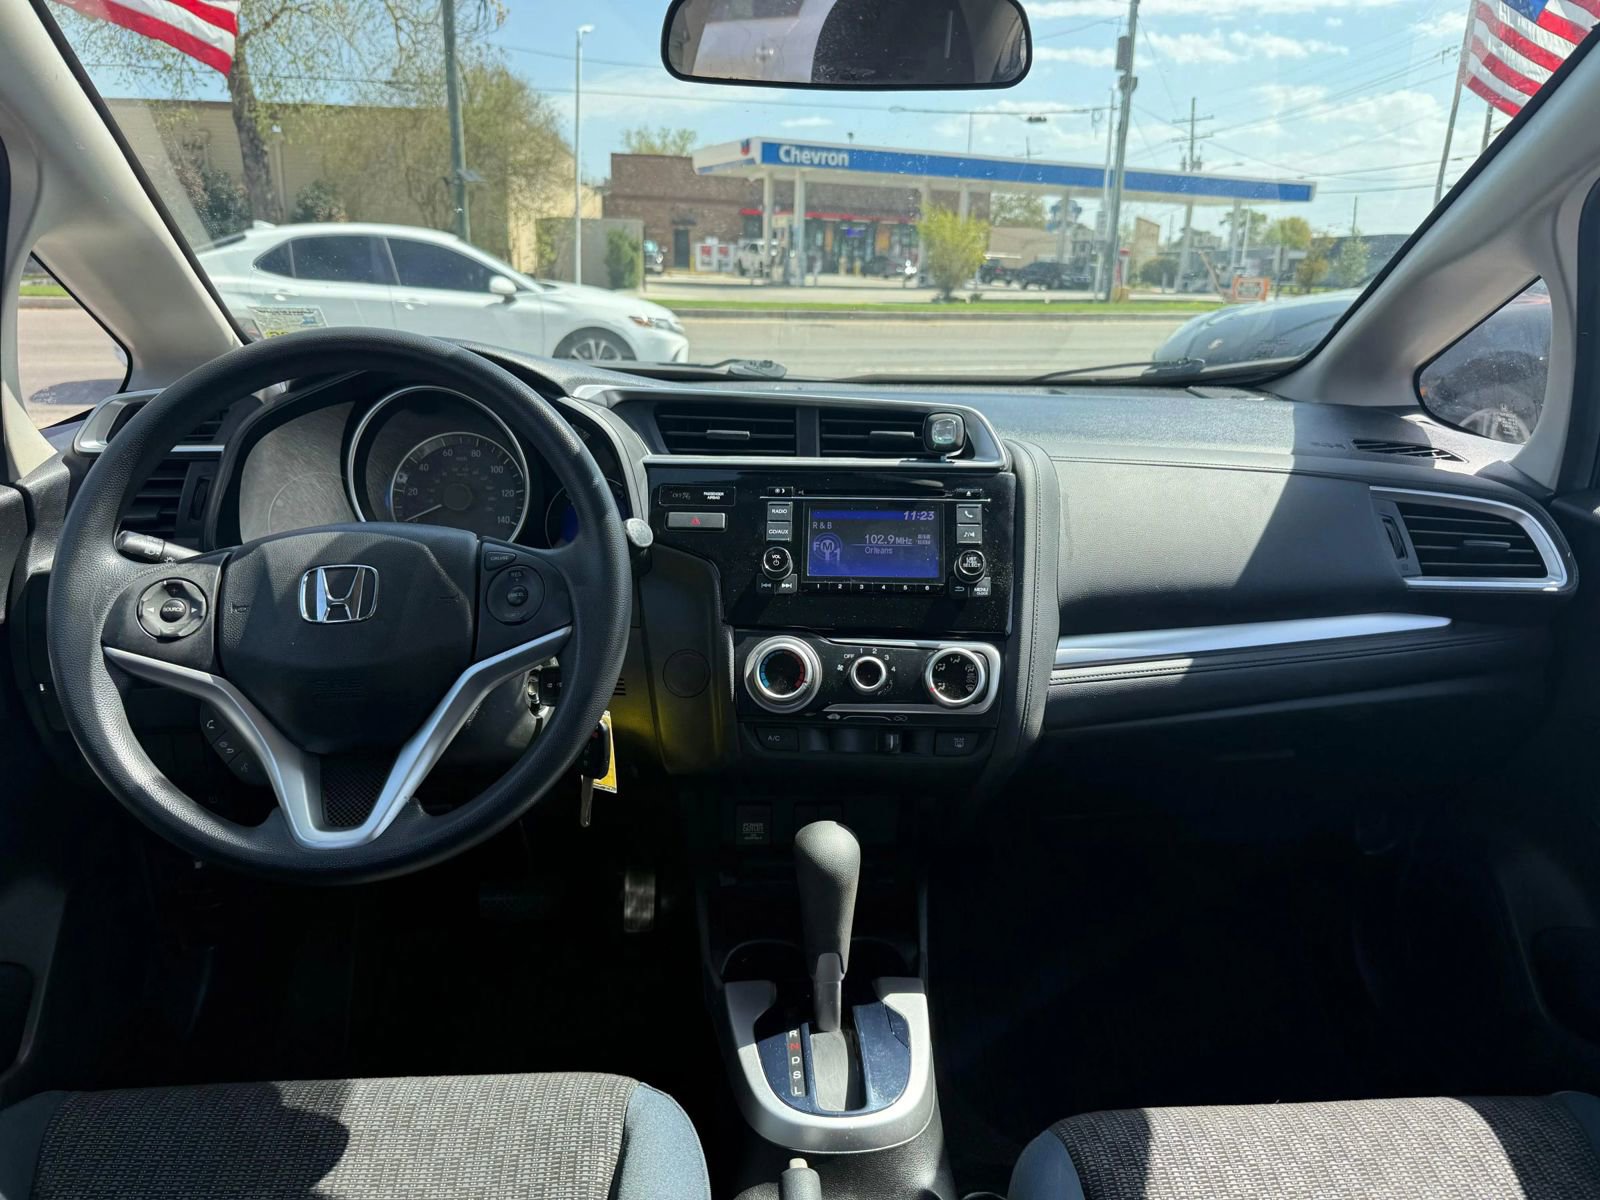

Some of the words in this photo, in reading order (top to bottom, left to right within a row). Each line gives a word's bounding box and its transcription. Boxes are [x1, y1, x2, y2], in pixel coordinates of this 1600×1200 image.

[778, 145, 850, 168] Chevron
[442, 449, 453, 457] 60
[471, 449, 481, 458] 80
[418, 463, 429, 471] 40
[490, 465, 504, 474] 100
[407, 488, 418, 496] 20
[502, 489, 515, 497] 120
[903, 511, 935, 520] 11:23
[497, 516, 511, 524] 140
[812, 521, 818, 529] R
[819, 521, 826, 529] &
[826, 521, 833, 529] B
[864, 534, 895, 544] 102.9
[895, 537, 913, 545] MHz
[864, 546, 893, 554] Orleans
[792, 1056, 800, 1064] D
[792, 1071, 801, 1079] S
[794, 1087, 802, 1095] L
